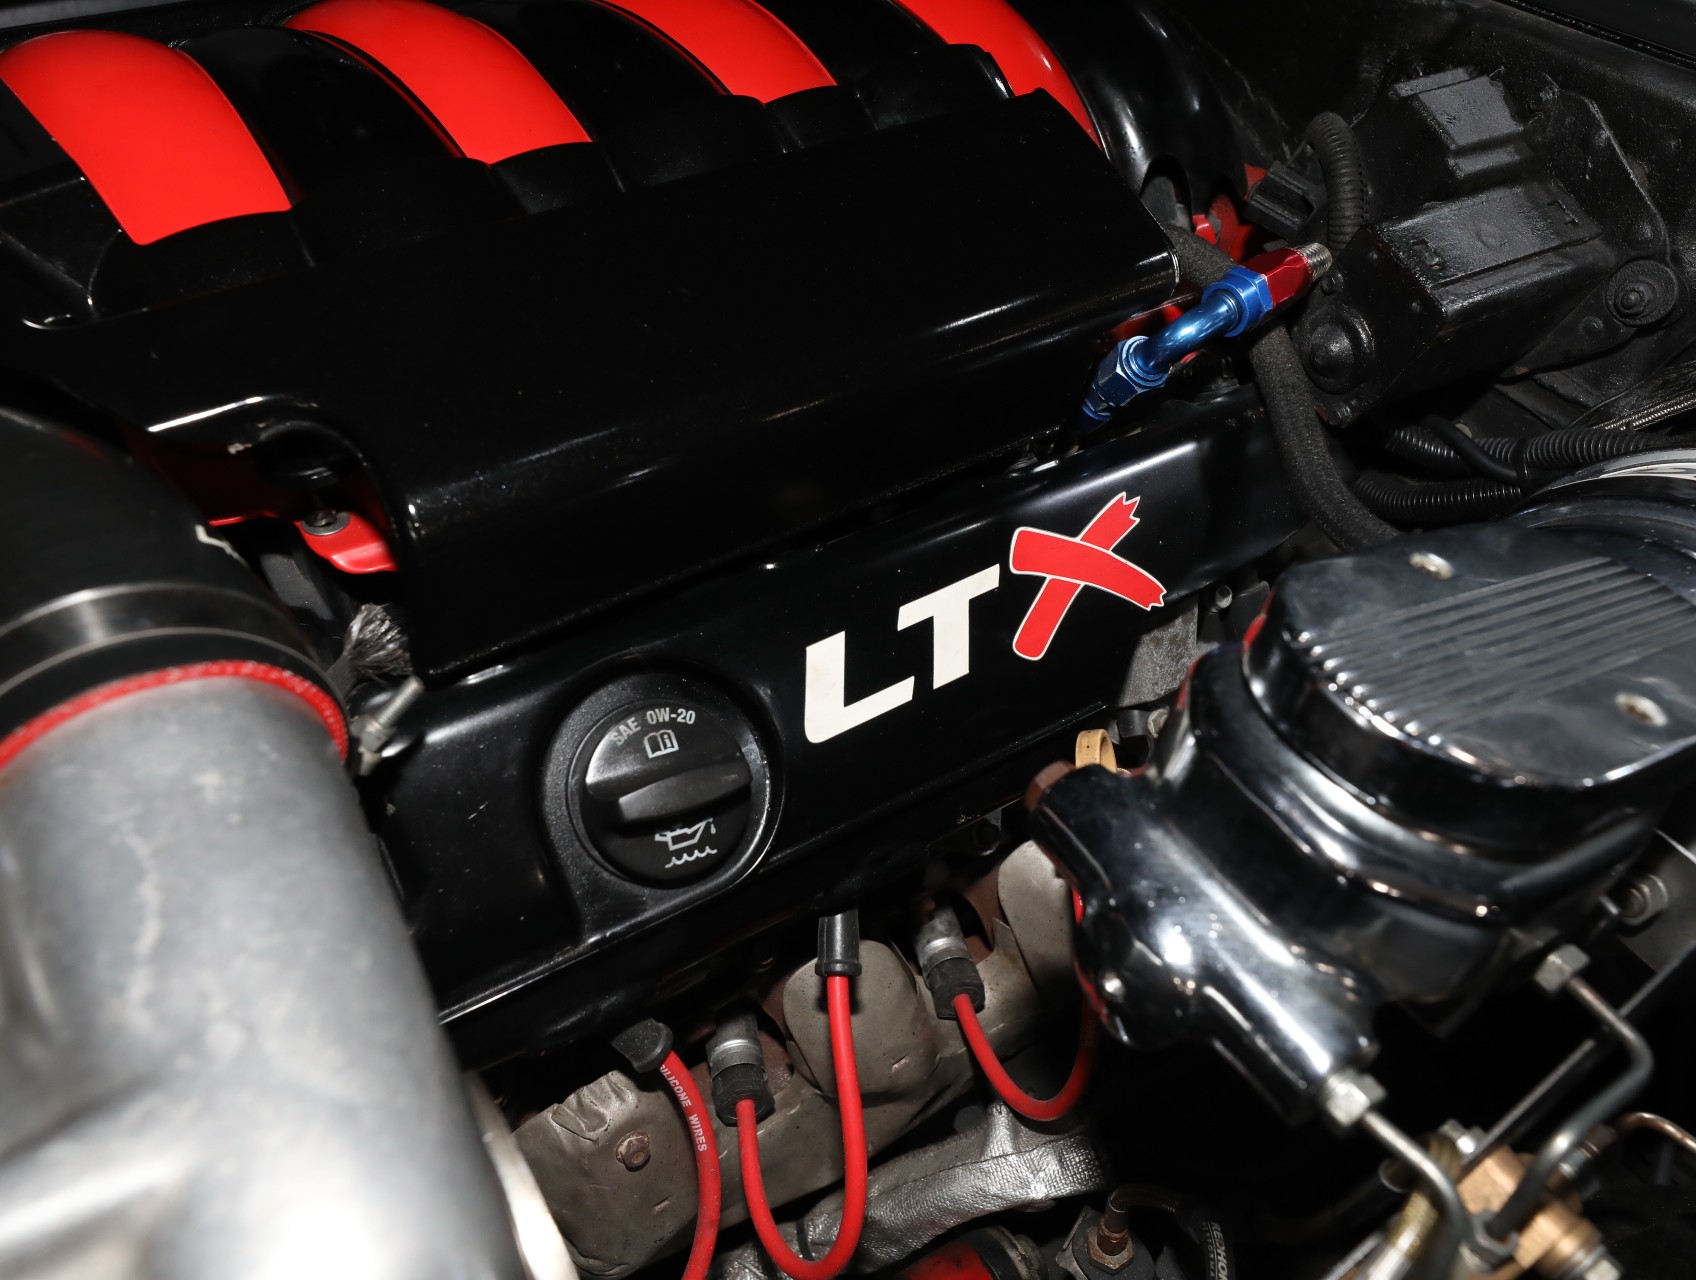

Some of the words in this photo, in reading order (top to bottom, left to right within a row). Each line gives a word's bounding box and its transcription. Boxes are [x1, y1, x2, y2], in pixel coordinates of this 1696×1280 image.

[804, 491, 1167, 744] LTX
[609, 716, 641, 746] SAE
[646, 707, 696, 725] 0W-20
[688, 1113, 707, 1152] WIRES
